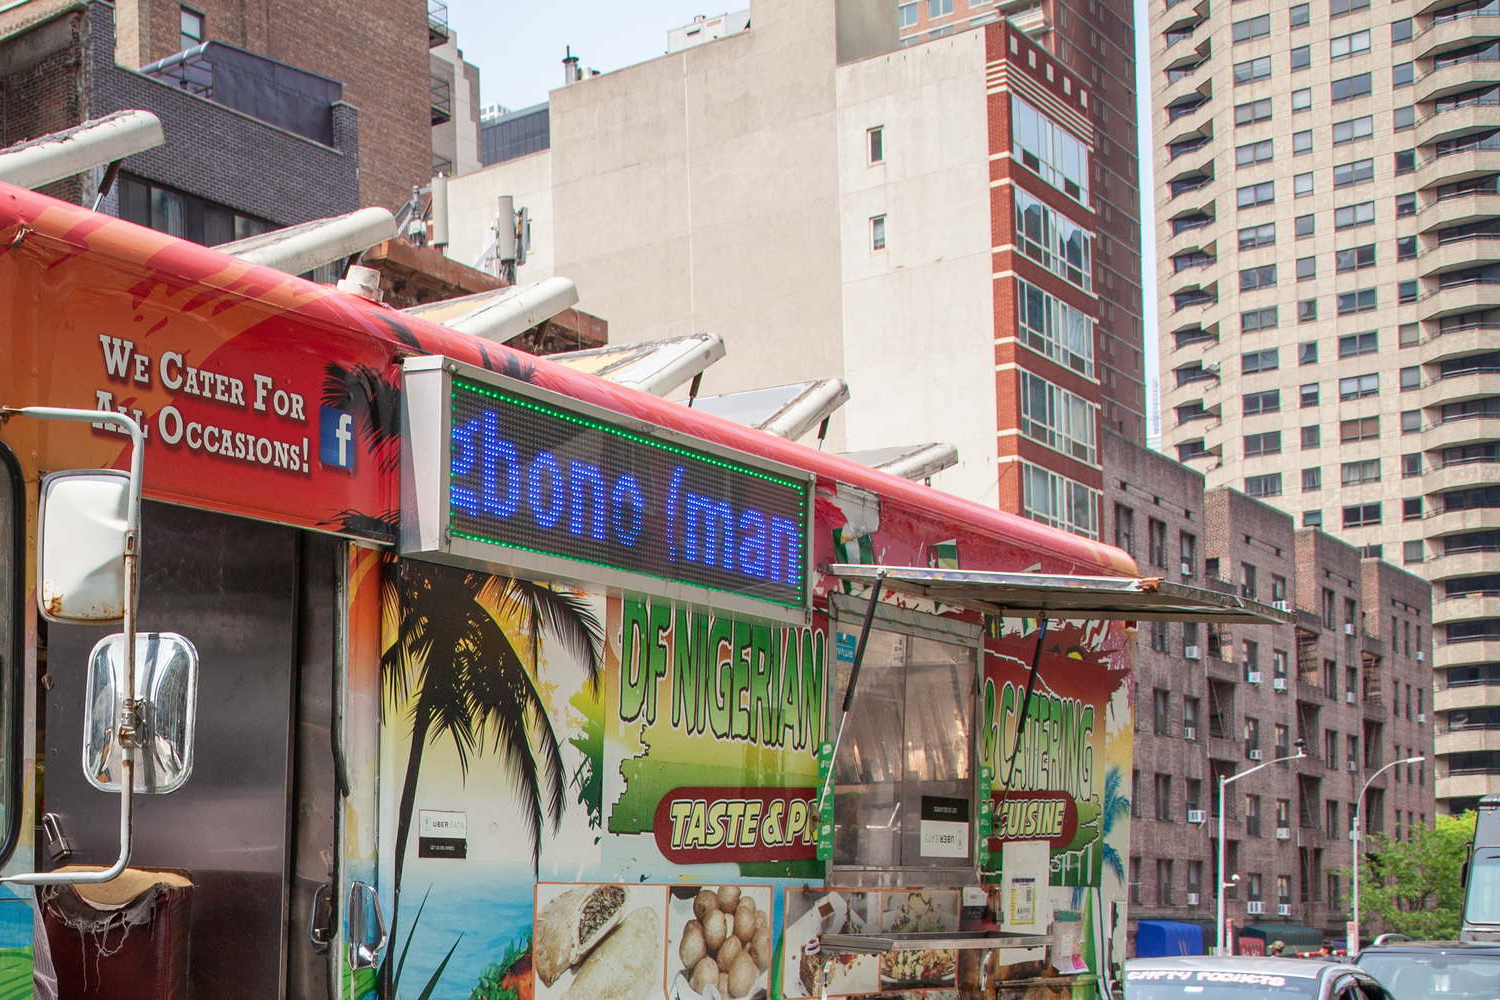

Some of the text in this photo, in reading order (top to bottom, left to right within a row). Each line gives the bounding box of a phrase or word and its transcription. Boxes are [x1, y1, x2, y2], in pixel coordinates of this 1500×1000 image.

[618, 600, 827, 760] DF NIGERIAN
[982, 677, 1096, 803] & CATERING
[432, 820, 465, 829] UBER EATS
[671, 799, 763, 850] TASTE
[761, 799, 787, 849] &
[924, 834, 955, 844] UBER EATS
[998, 800, 1067, 839] CUISINE
[1127, 970, 1193, 981] EMPTY
